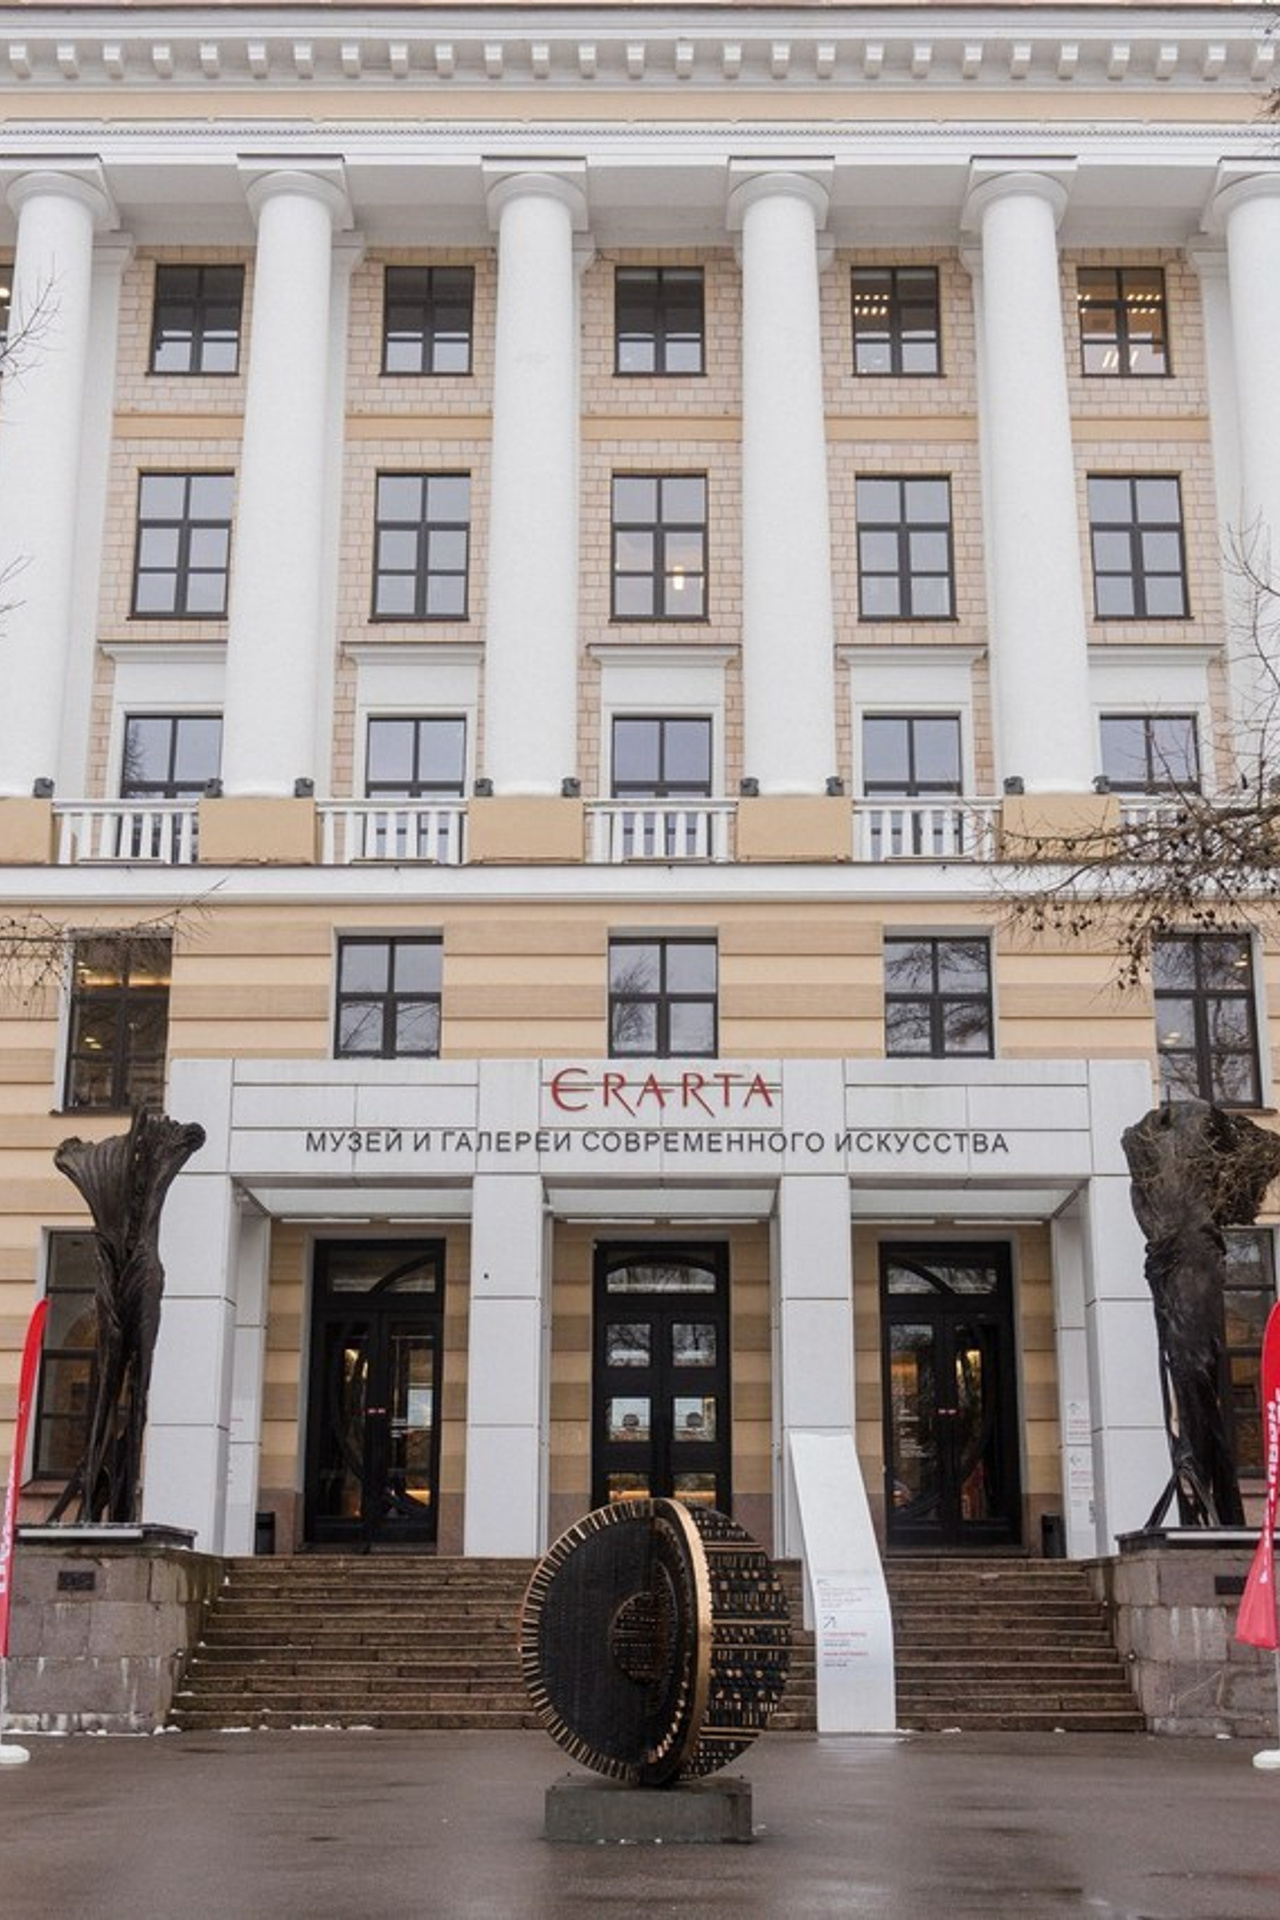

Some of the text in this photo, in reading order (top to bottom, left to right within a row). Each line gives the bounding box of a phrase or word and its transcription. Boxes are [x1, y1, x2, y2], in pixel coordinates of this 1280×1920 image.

[551, 1068, 778, 1117] ERARTA
[305, 1128, 1009, 1153] МУЗЕЙ И ГАЛЕРЕИ СОВРЕМЕННОГО ИСКУССТВА
